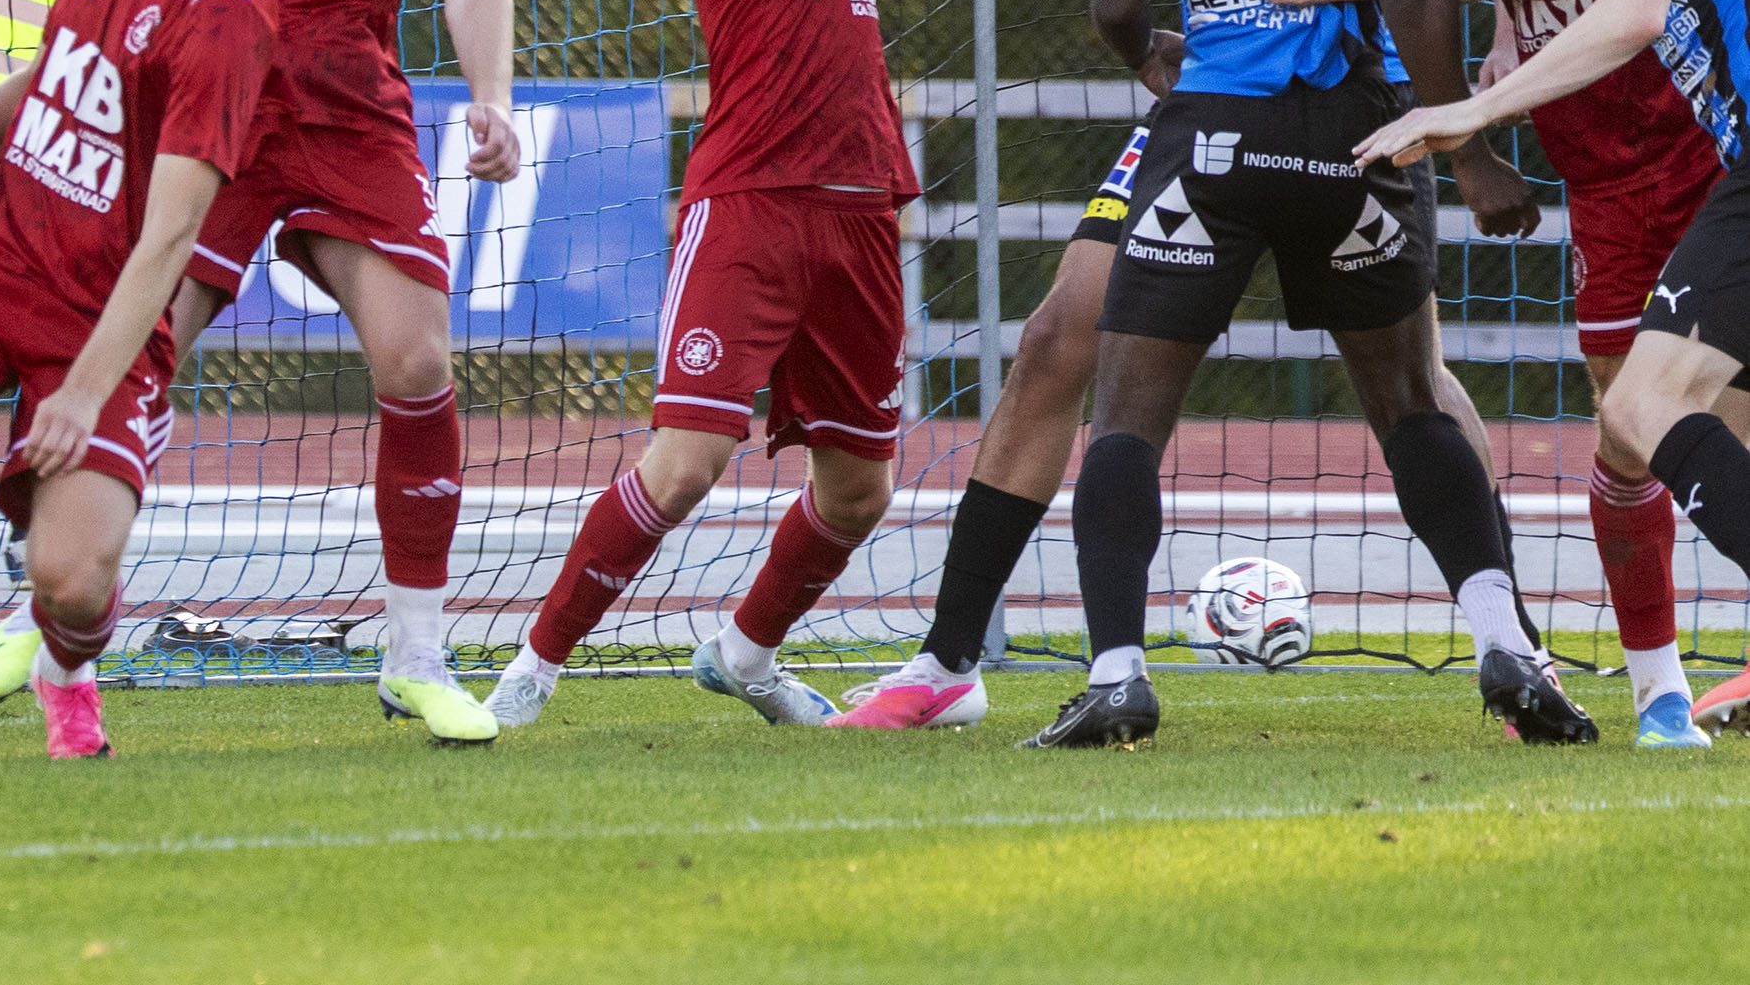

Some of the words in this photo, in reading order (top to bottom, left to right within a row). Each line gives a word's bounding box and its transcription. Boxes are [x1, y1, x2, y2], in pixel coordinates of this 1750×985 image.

[38, 26, 124, 134] KB
[12, 96, 124, 201] MAXI
[1243, 151, 1304, 173] INDOOR
[1308, 161, 1366, 178] ENERGY
[1125, 237, 1215, 266] Ramudden
[1330, 232, 1409, 272] Ramudden
